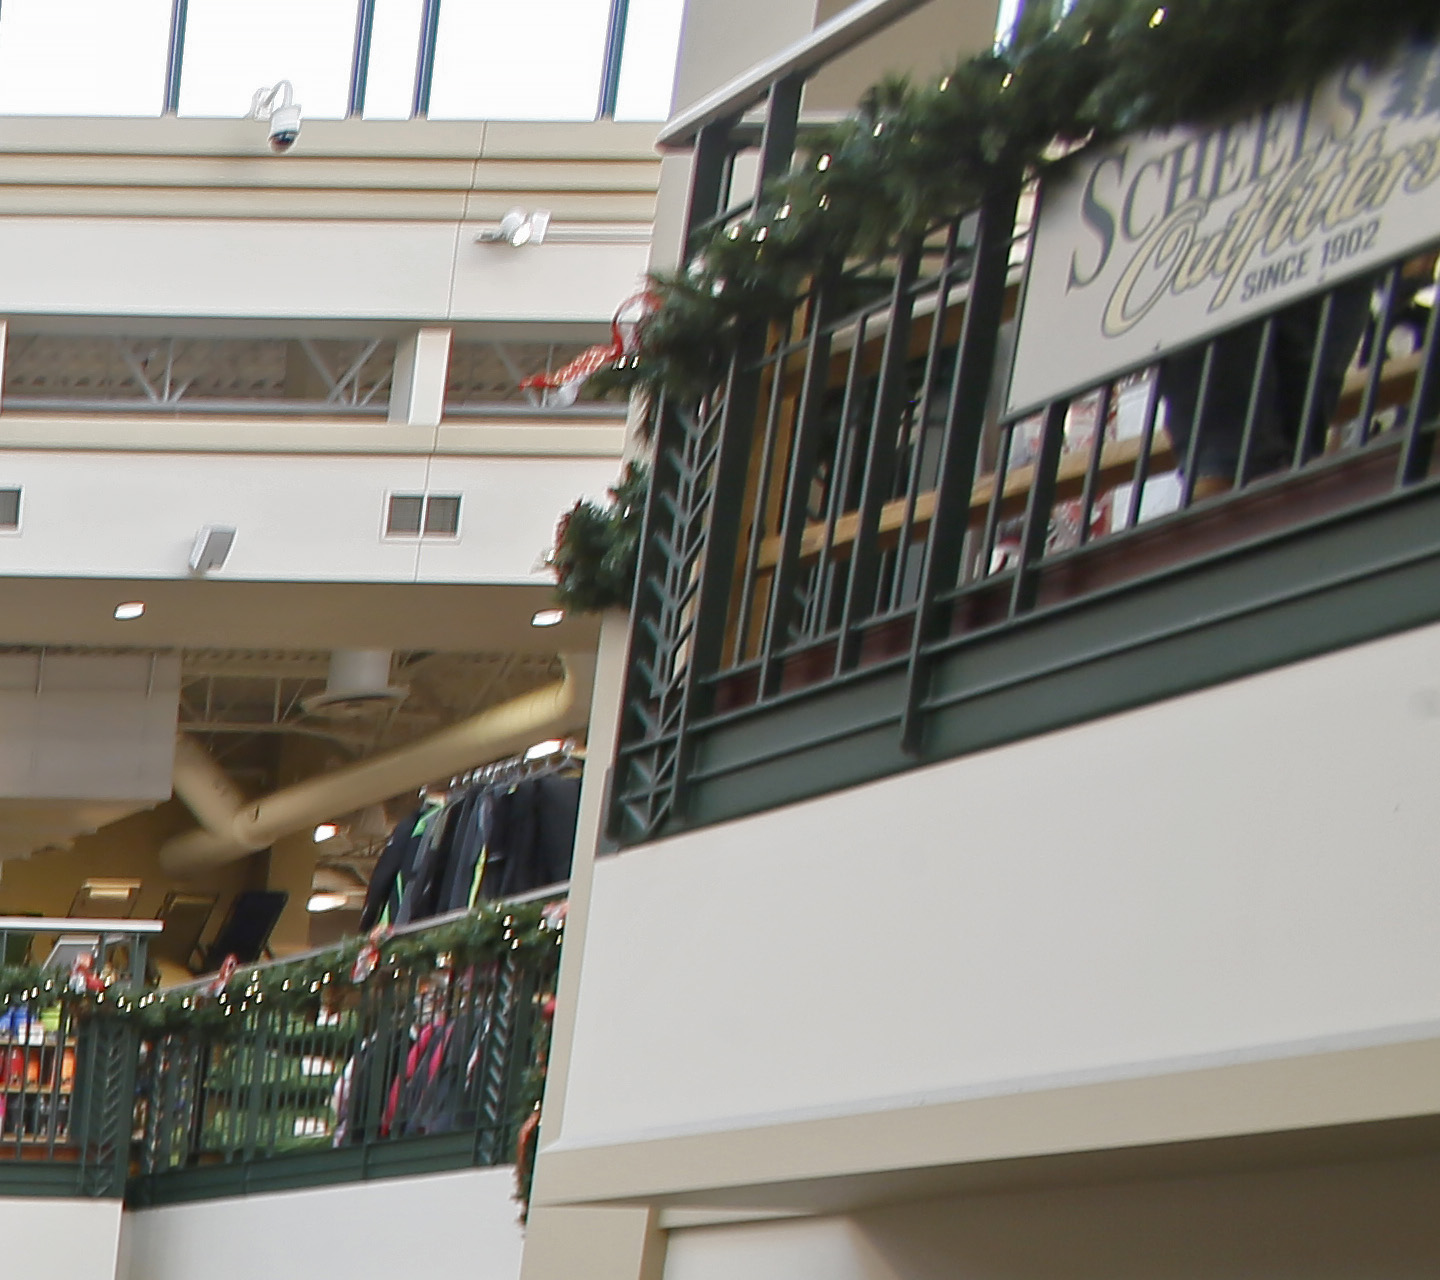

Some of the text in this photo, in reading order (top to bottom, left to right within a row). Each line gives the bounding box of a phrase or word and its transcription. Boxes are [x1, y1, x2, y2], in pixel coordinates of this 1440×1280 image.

[1101, 130, 1440, 338] Outfitters
[1241, 219, 1380, 302] SINCE 1902
